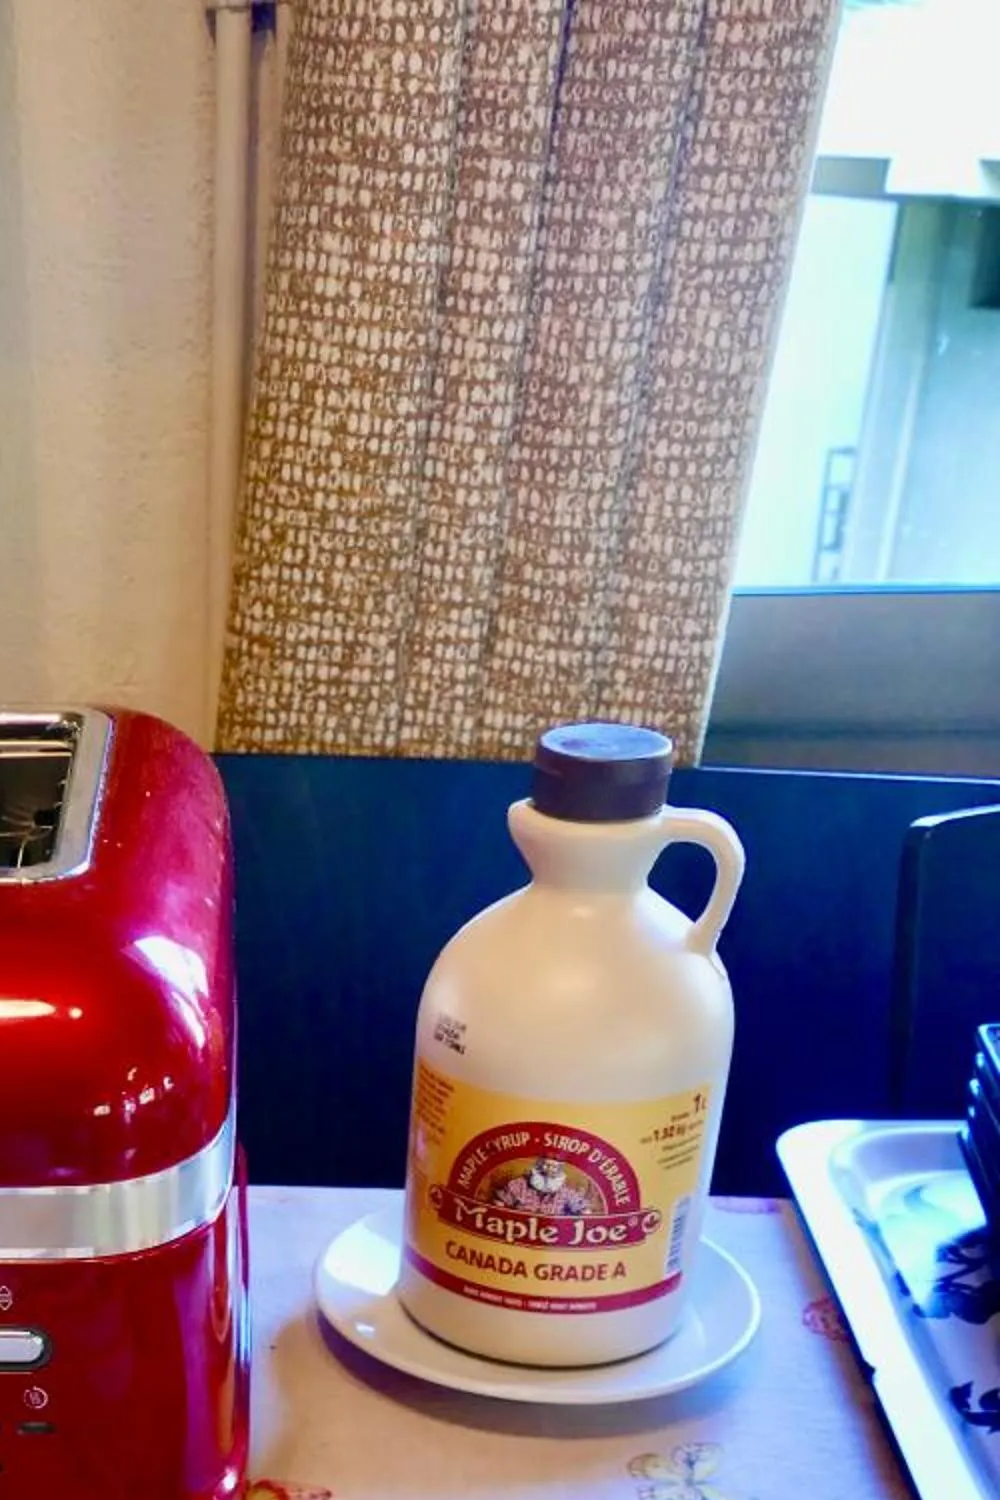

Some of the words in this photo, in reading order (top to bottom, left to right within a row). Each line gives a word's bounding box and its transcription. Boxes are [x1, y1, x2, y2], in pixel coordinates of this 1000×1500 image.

[457, 1147, 489, 1189] MAPLE
[543, 1132, 590, 1154] SIROP
[454, 1197, 559, 1242] Maple
[445, 1240, 528, 1279] CANADA
[534, 1261, 609, 1281] GRADE
[613, 1262, 627, 1278] A
